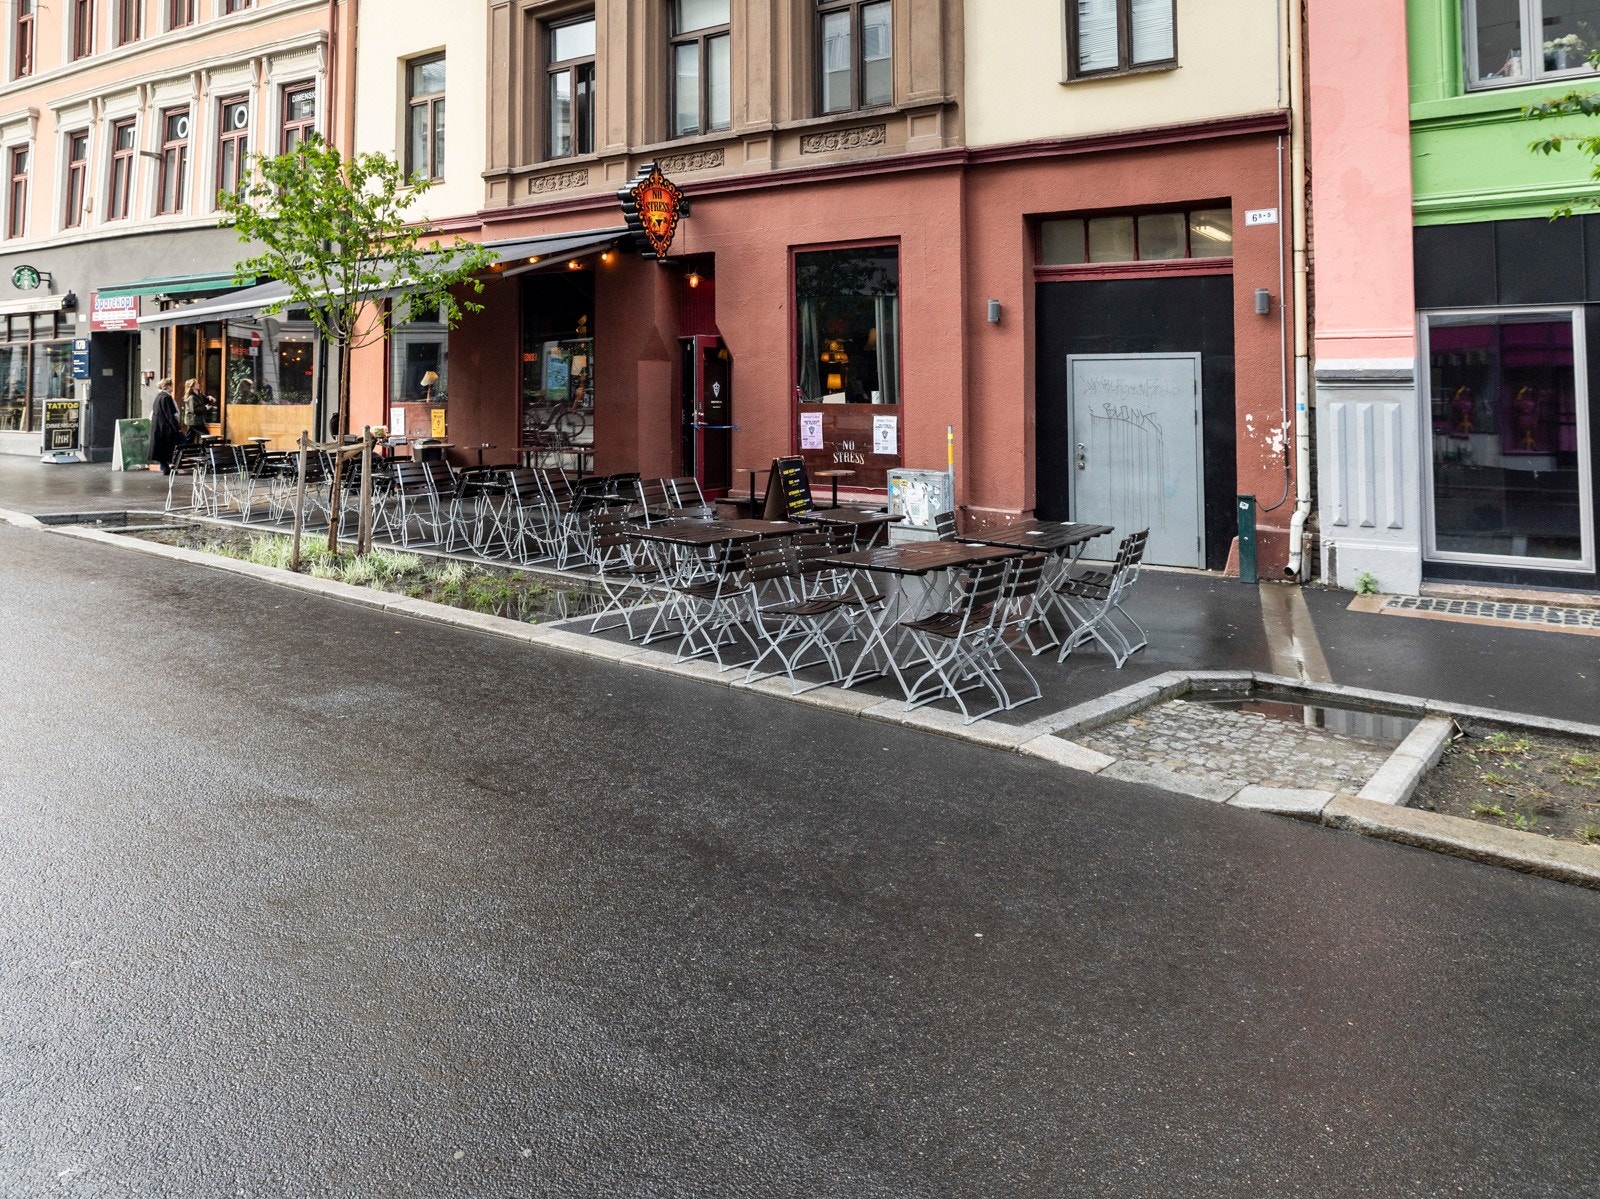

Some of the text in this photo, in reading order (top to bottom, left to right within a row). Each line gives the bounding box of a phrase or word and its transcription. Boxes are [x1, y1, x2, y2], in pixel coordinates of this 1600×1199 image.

[652, 190, 663, 199] NO
[645, 201, 670, 212] STRESS
[55, 434, 70, 444] INK
[842, 440, 855, 450] NO
[833, 452, 865, 465] STRESS
